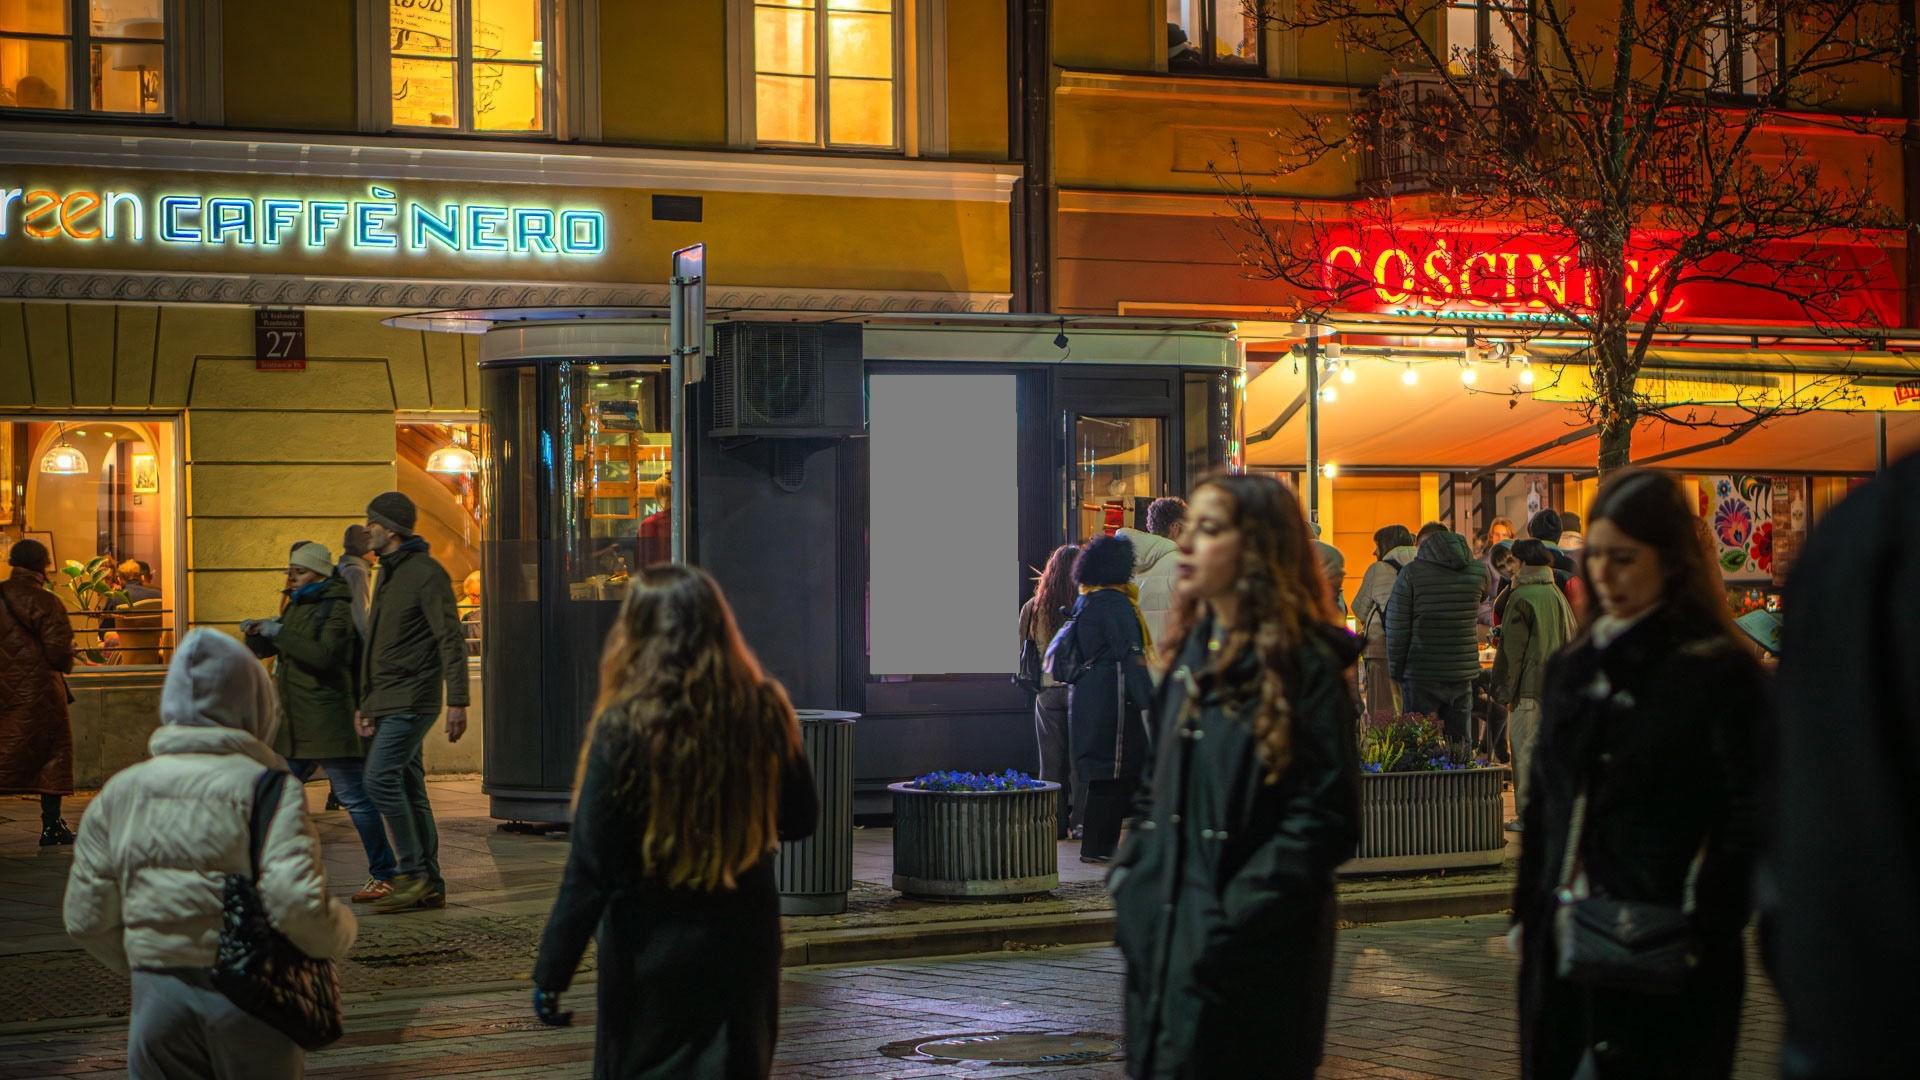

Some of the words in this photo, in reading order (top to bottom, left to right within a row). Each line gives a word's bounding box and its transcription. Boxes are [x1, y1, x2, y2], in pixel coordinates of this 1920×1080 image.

[159, 186, 397, 247] CAFFÈ
[411, 203, 605, 254] NERO
[266, 330, 297, 358] 27
